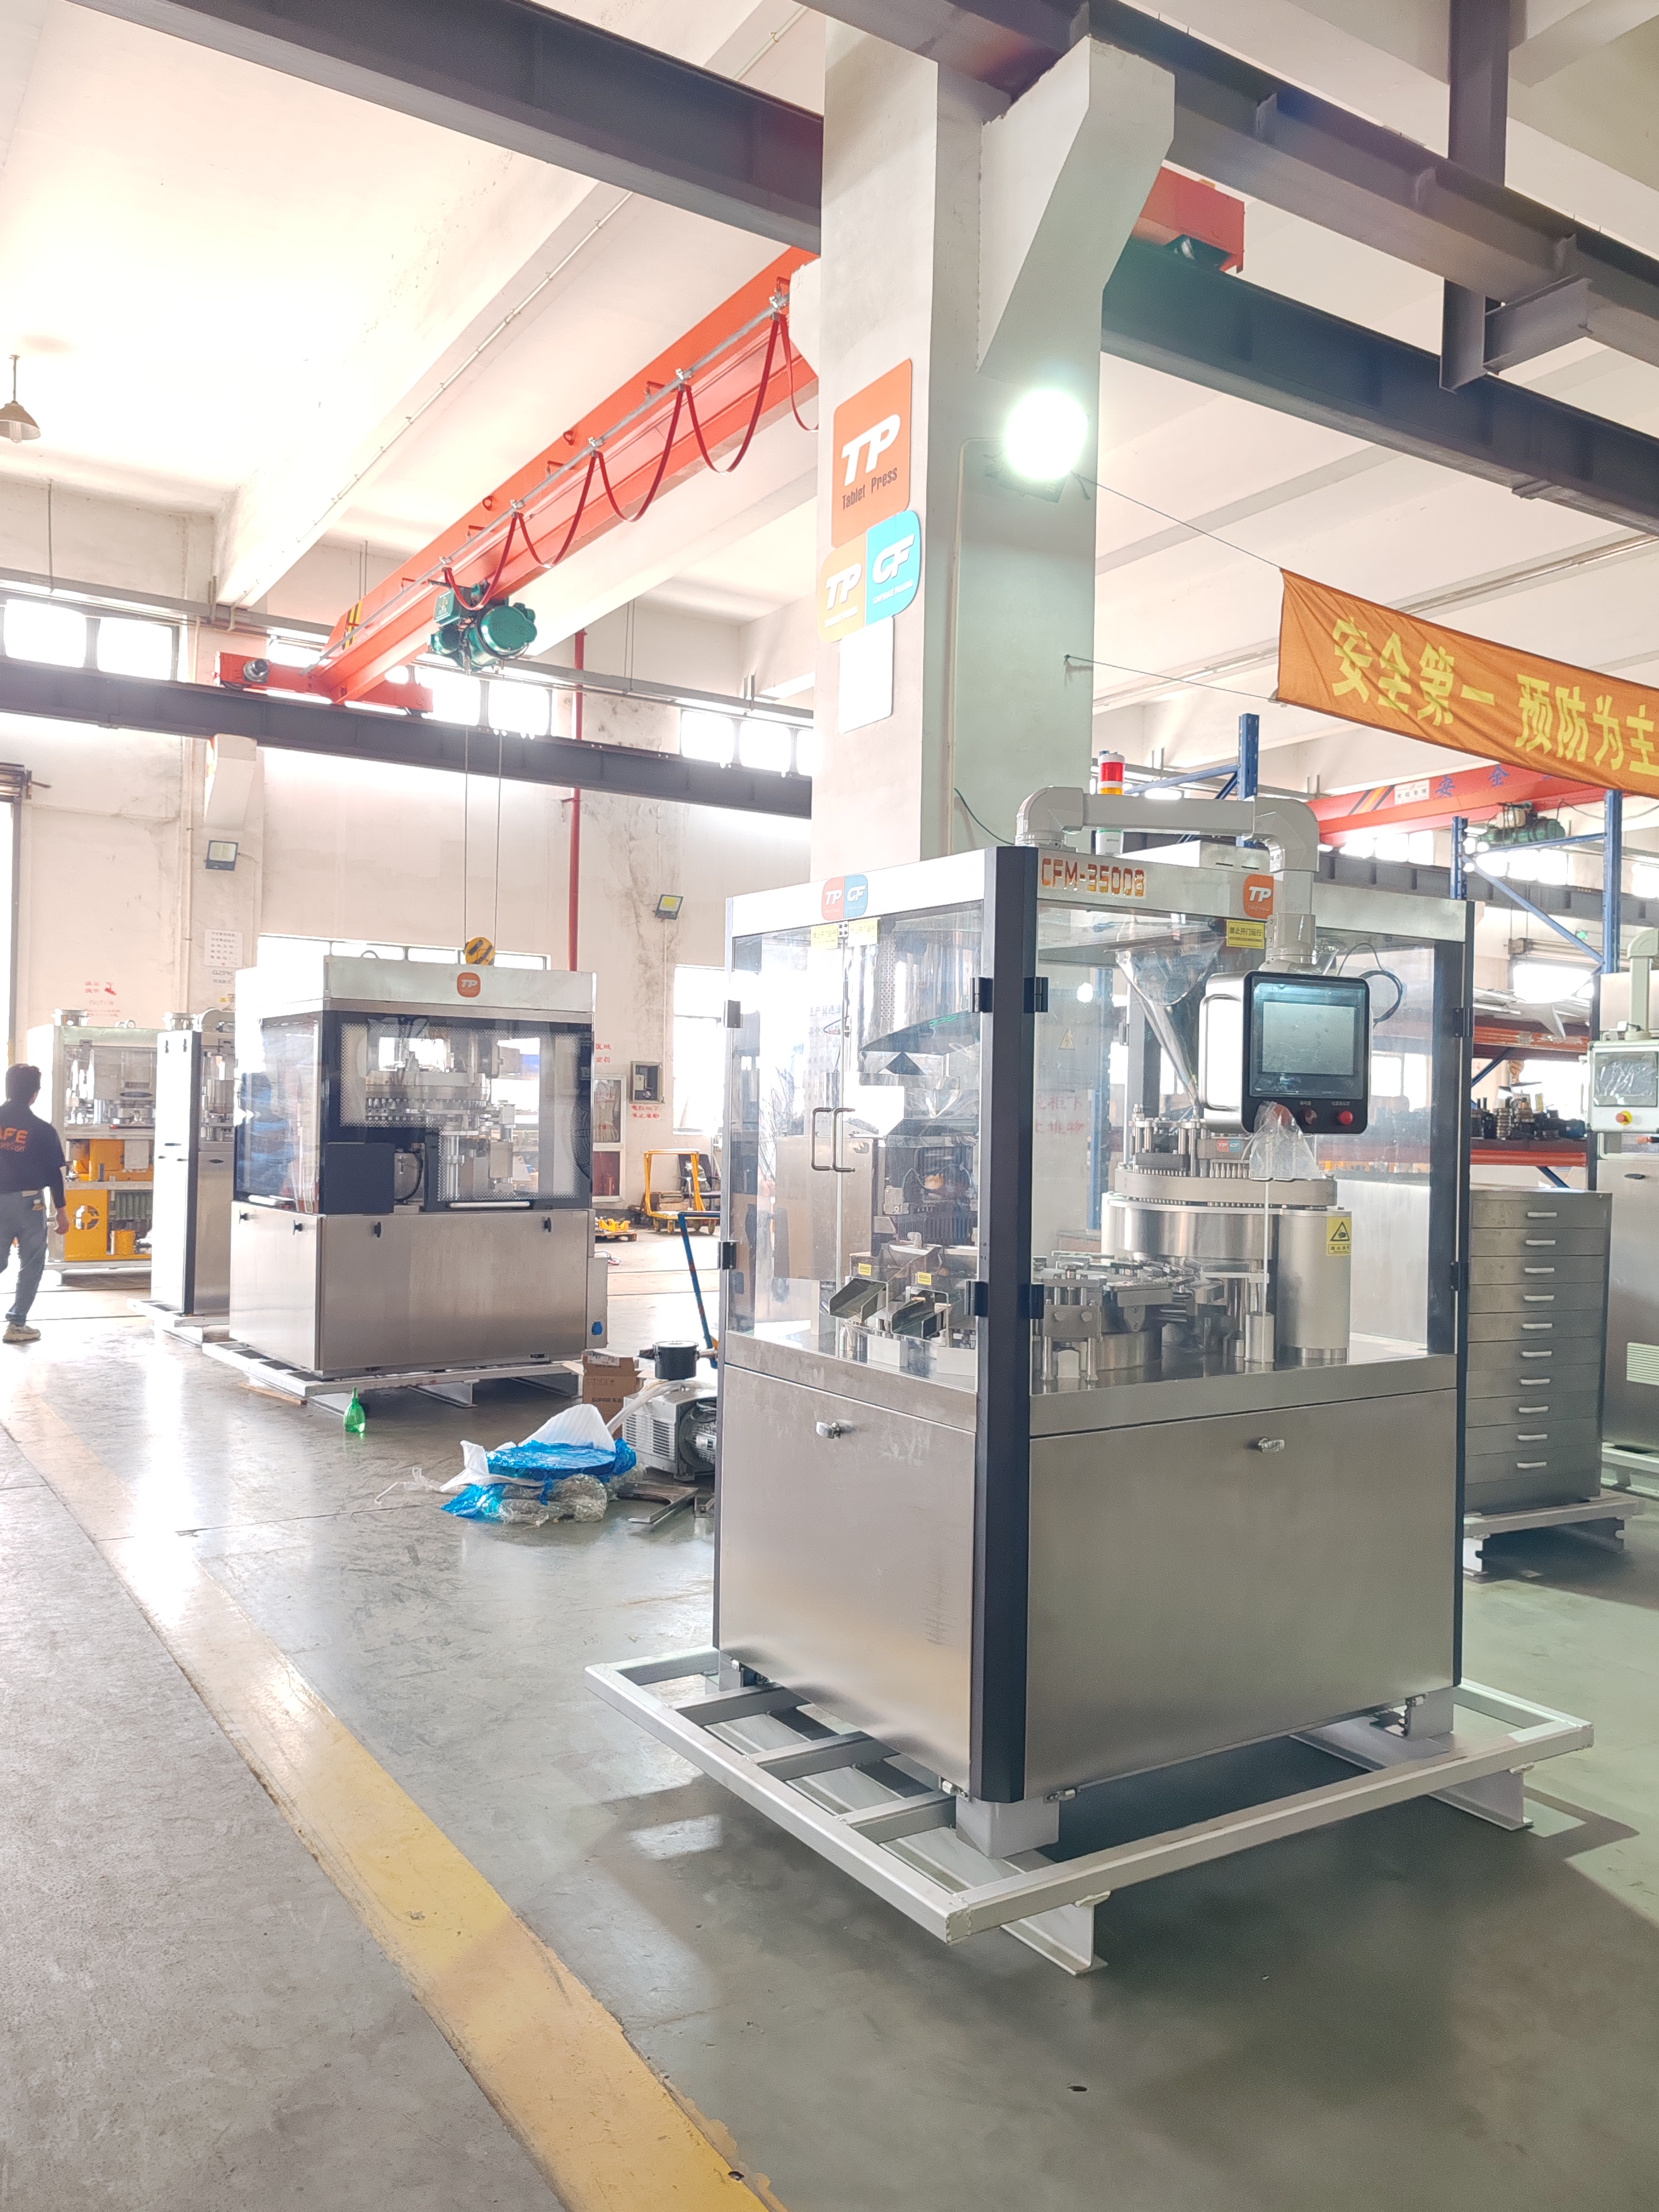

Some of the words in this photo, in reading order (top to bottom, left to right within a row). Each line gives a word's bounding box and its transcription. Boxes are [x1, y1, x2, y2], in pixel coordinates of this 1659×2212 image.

[841, 414, 901, 487] TP
[842, 484, 865, 511] Tablet
[871, 468, 898, 494] Press
[872, 534, 915, 585] CF
[826, 563, 862, 610] TP
[1332, 616, 1495, 727] 安全第一
[1515, 674, 1659, 777] 预防为主
[826, 889, 843, 905] TP
[847, 885, 867, 902] CF
[1249, 886, 1271, 902] TP
[462, 979, 478, 988] TP
